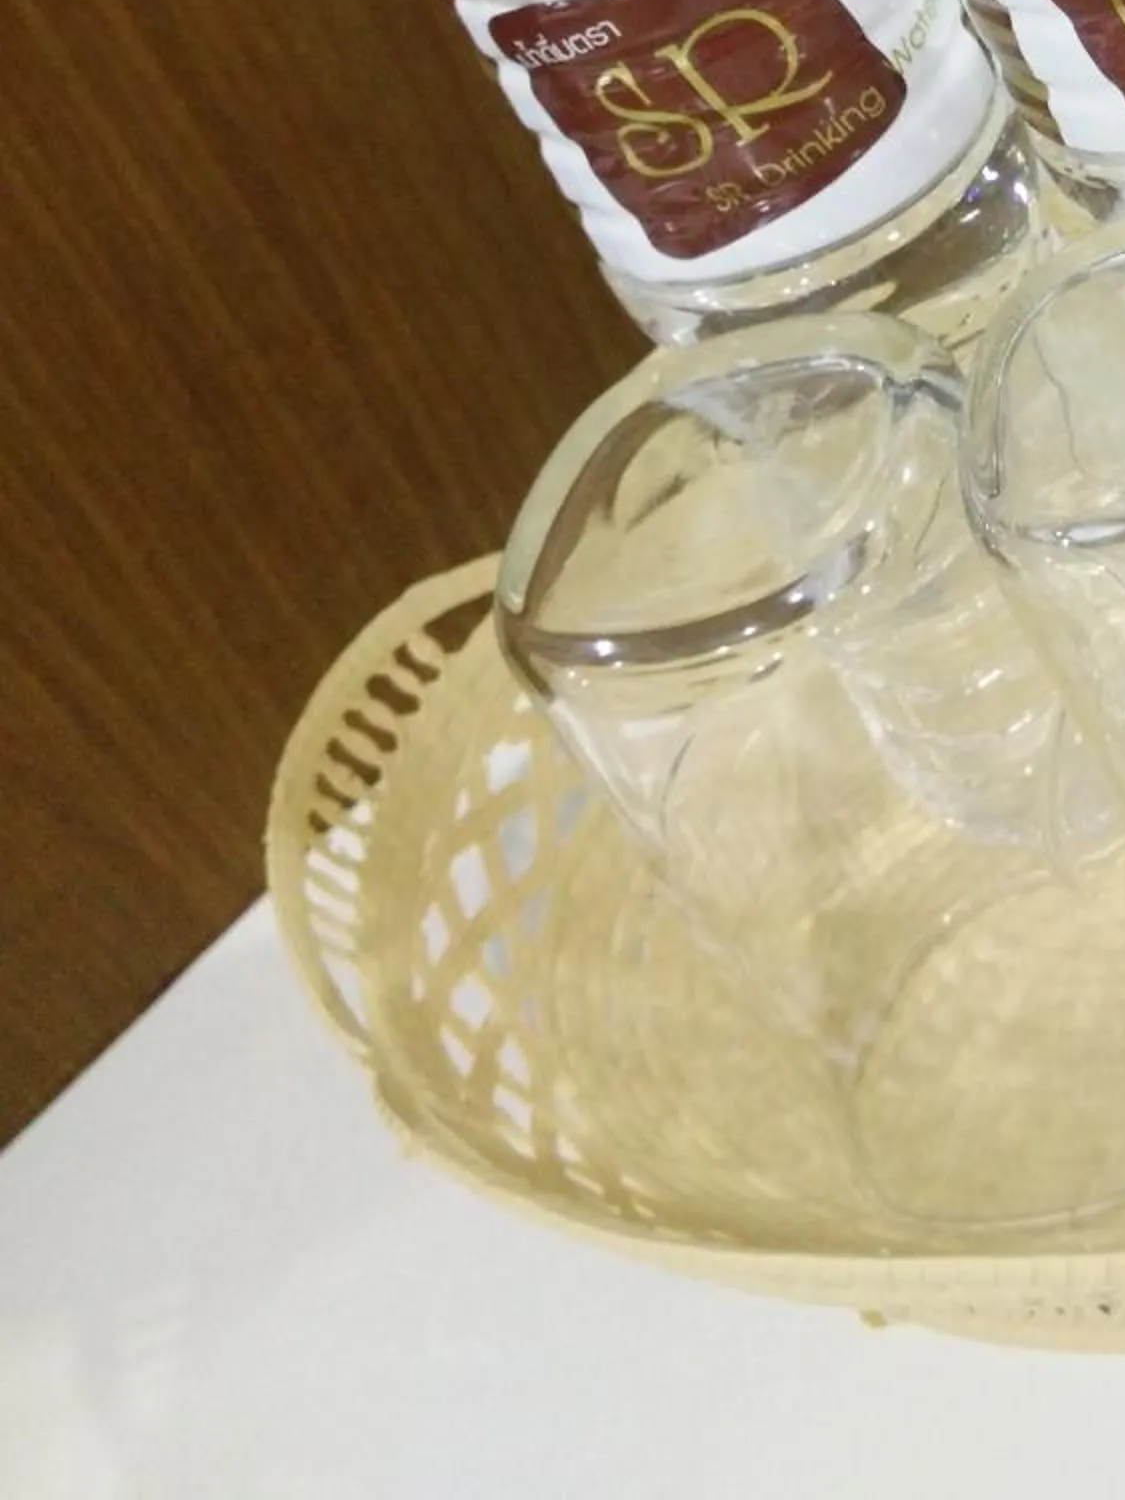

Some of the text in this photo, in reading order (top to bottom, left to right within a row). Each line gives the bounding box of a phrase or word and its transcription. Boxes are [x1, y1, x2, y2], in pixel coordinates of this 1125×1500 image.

[595, 6, 833, 177] SR
[705, 182, 746, 213] SR
[754, 84, 887, 187] Drinking
